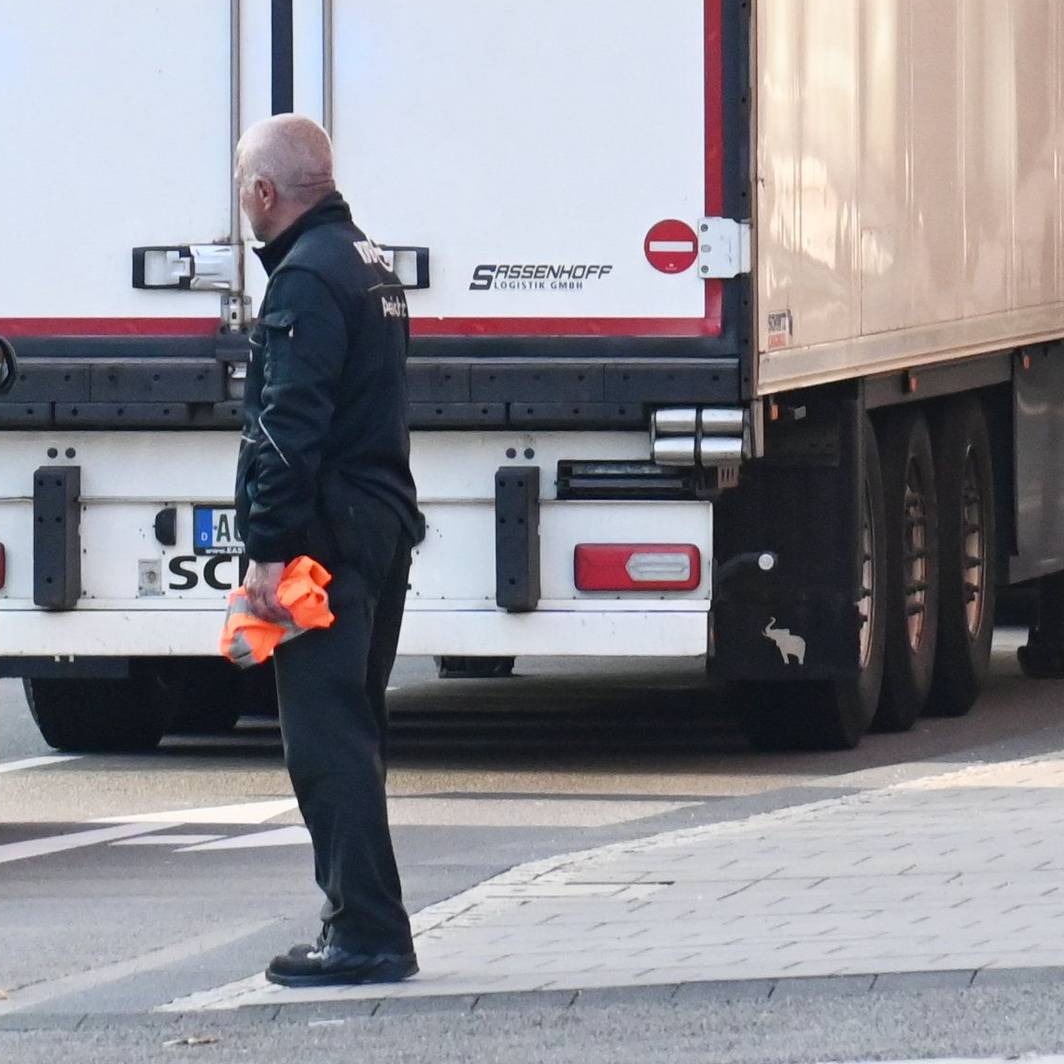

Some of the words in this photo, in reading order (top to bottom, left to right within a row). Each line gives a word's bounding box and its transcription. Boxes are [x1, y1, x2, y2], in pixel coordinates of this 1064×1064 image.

[469, 264, 613, 290] SASSENHOFF
[494, 281, 545, 290] LOGISTIK
[550, 281, 583, 290] GMBH
[168, 555, 249, 591] SC
